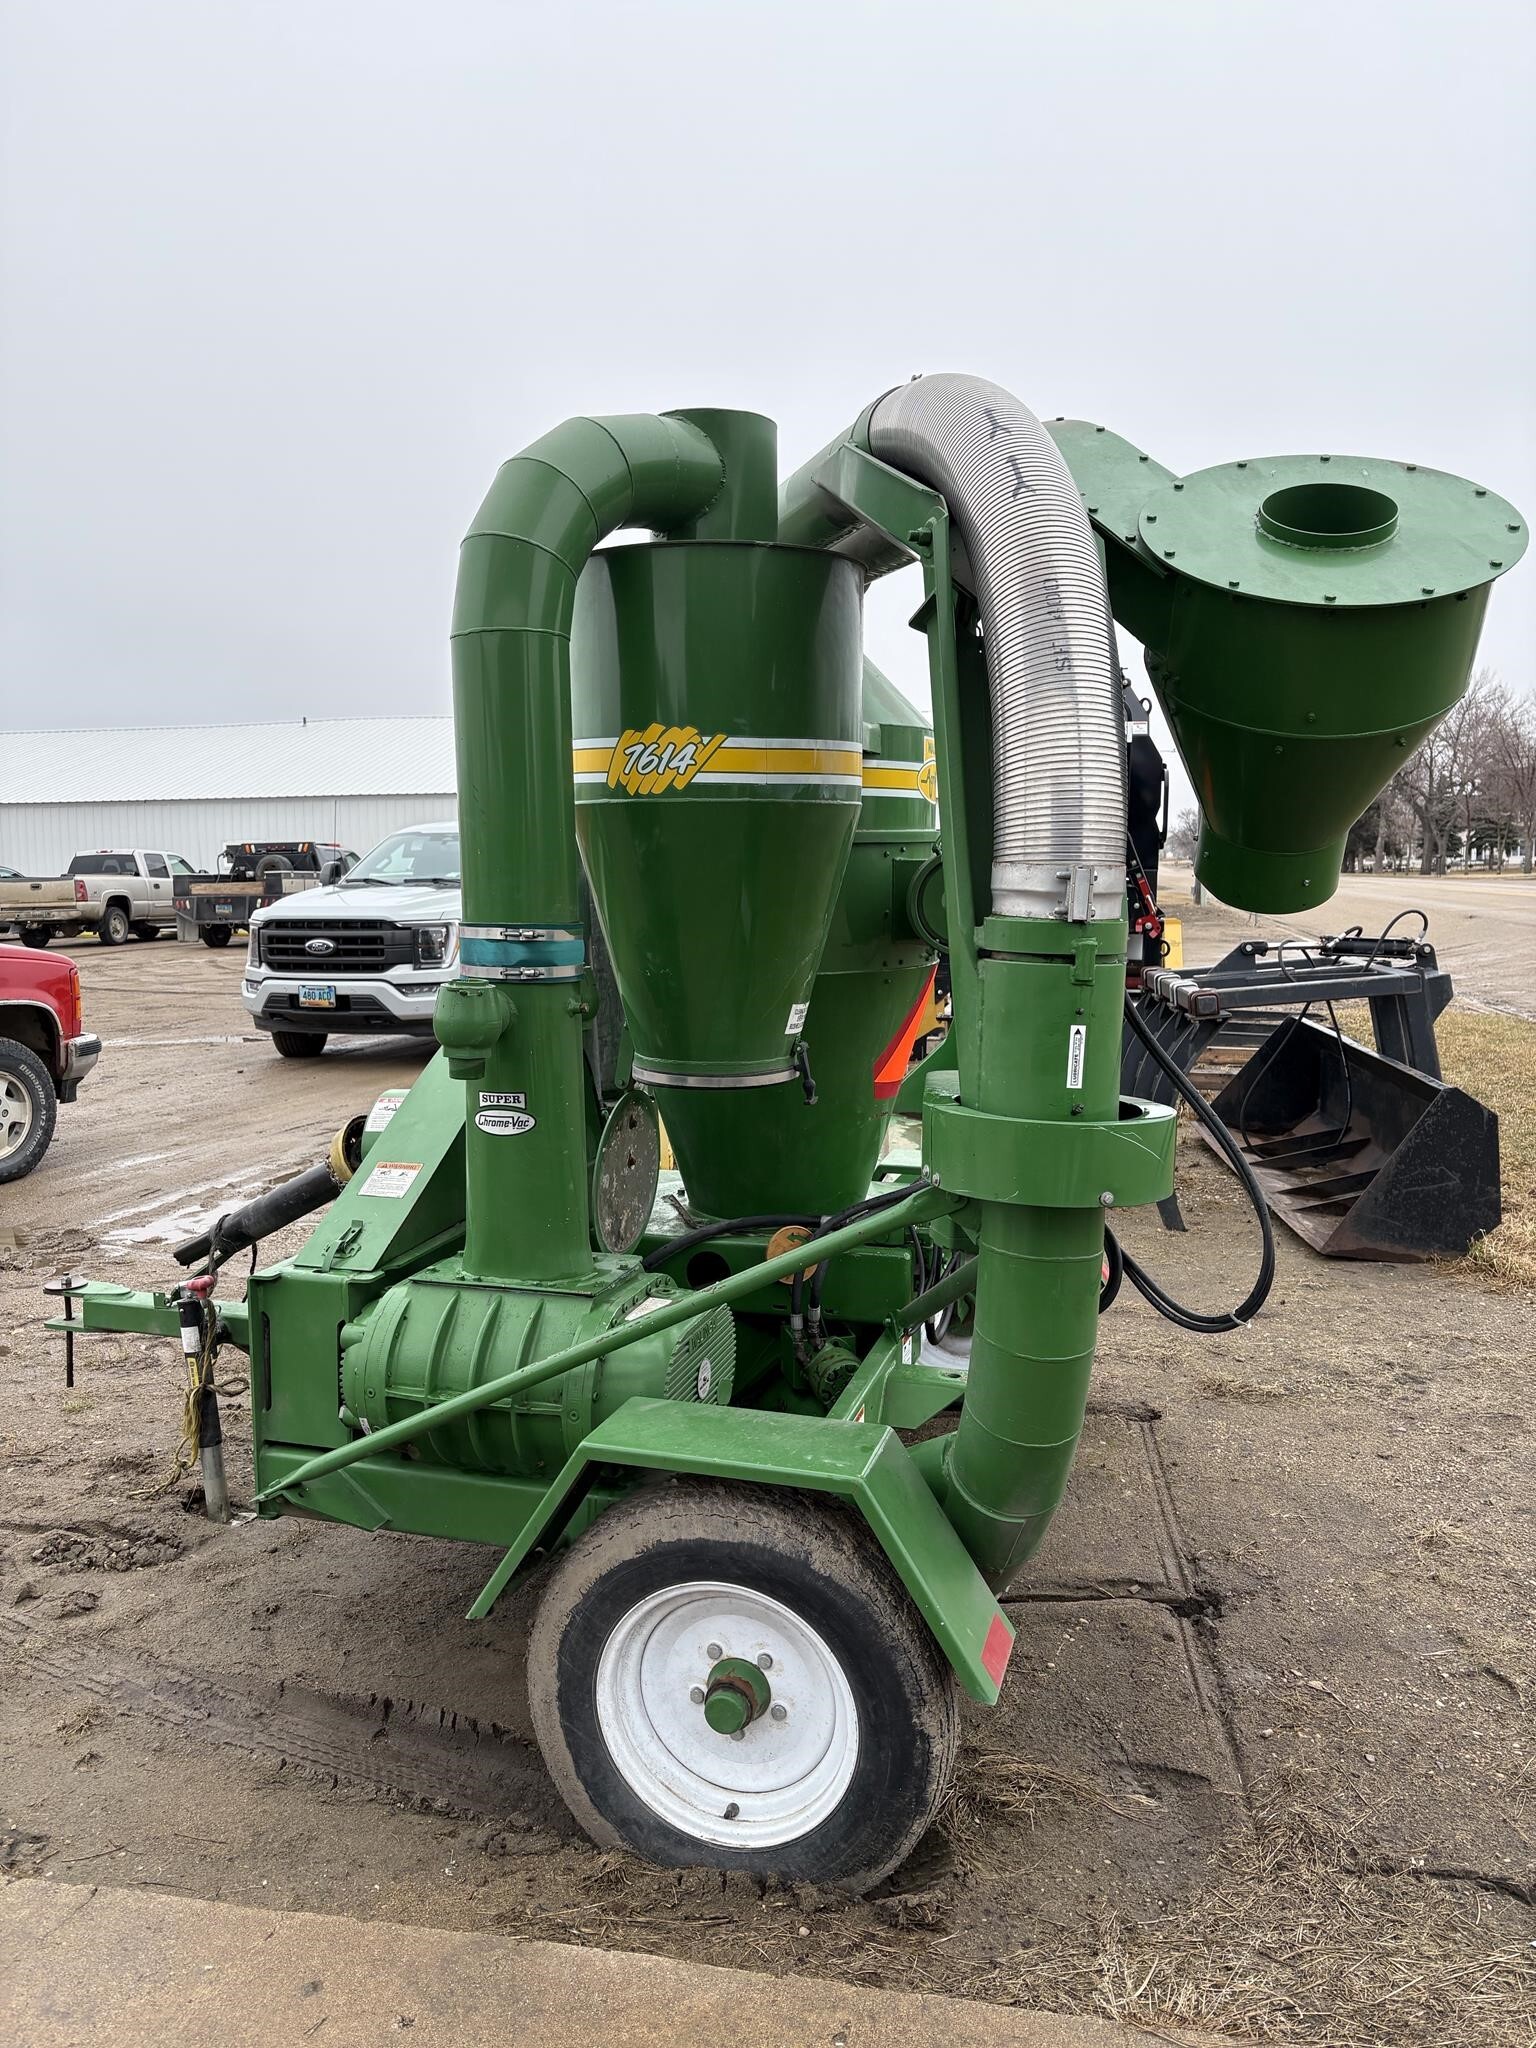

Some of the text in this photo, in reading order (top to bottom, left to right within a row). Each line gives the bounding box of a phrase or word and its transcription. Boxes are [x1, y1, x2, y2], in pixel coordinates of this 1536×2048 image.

[623, 741, 698, 775] 7614
[311, 942, 328, 951] Ford
[303, 991, 332, 1001] 480 ACD
[481, 1094, 521, 1104] SUPER
[478, 1114, 529, 1127] Chrome-Vac
